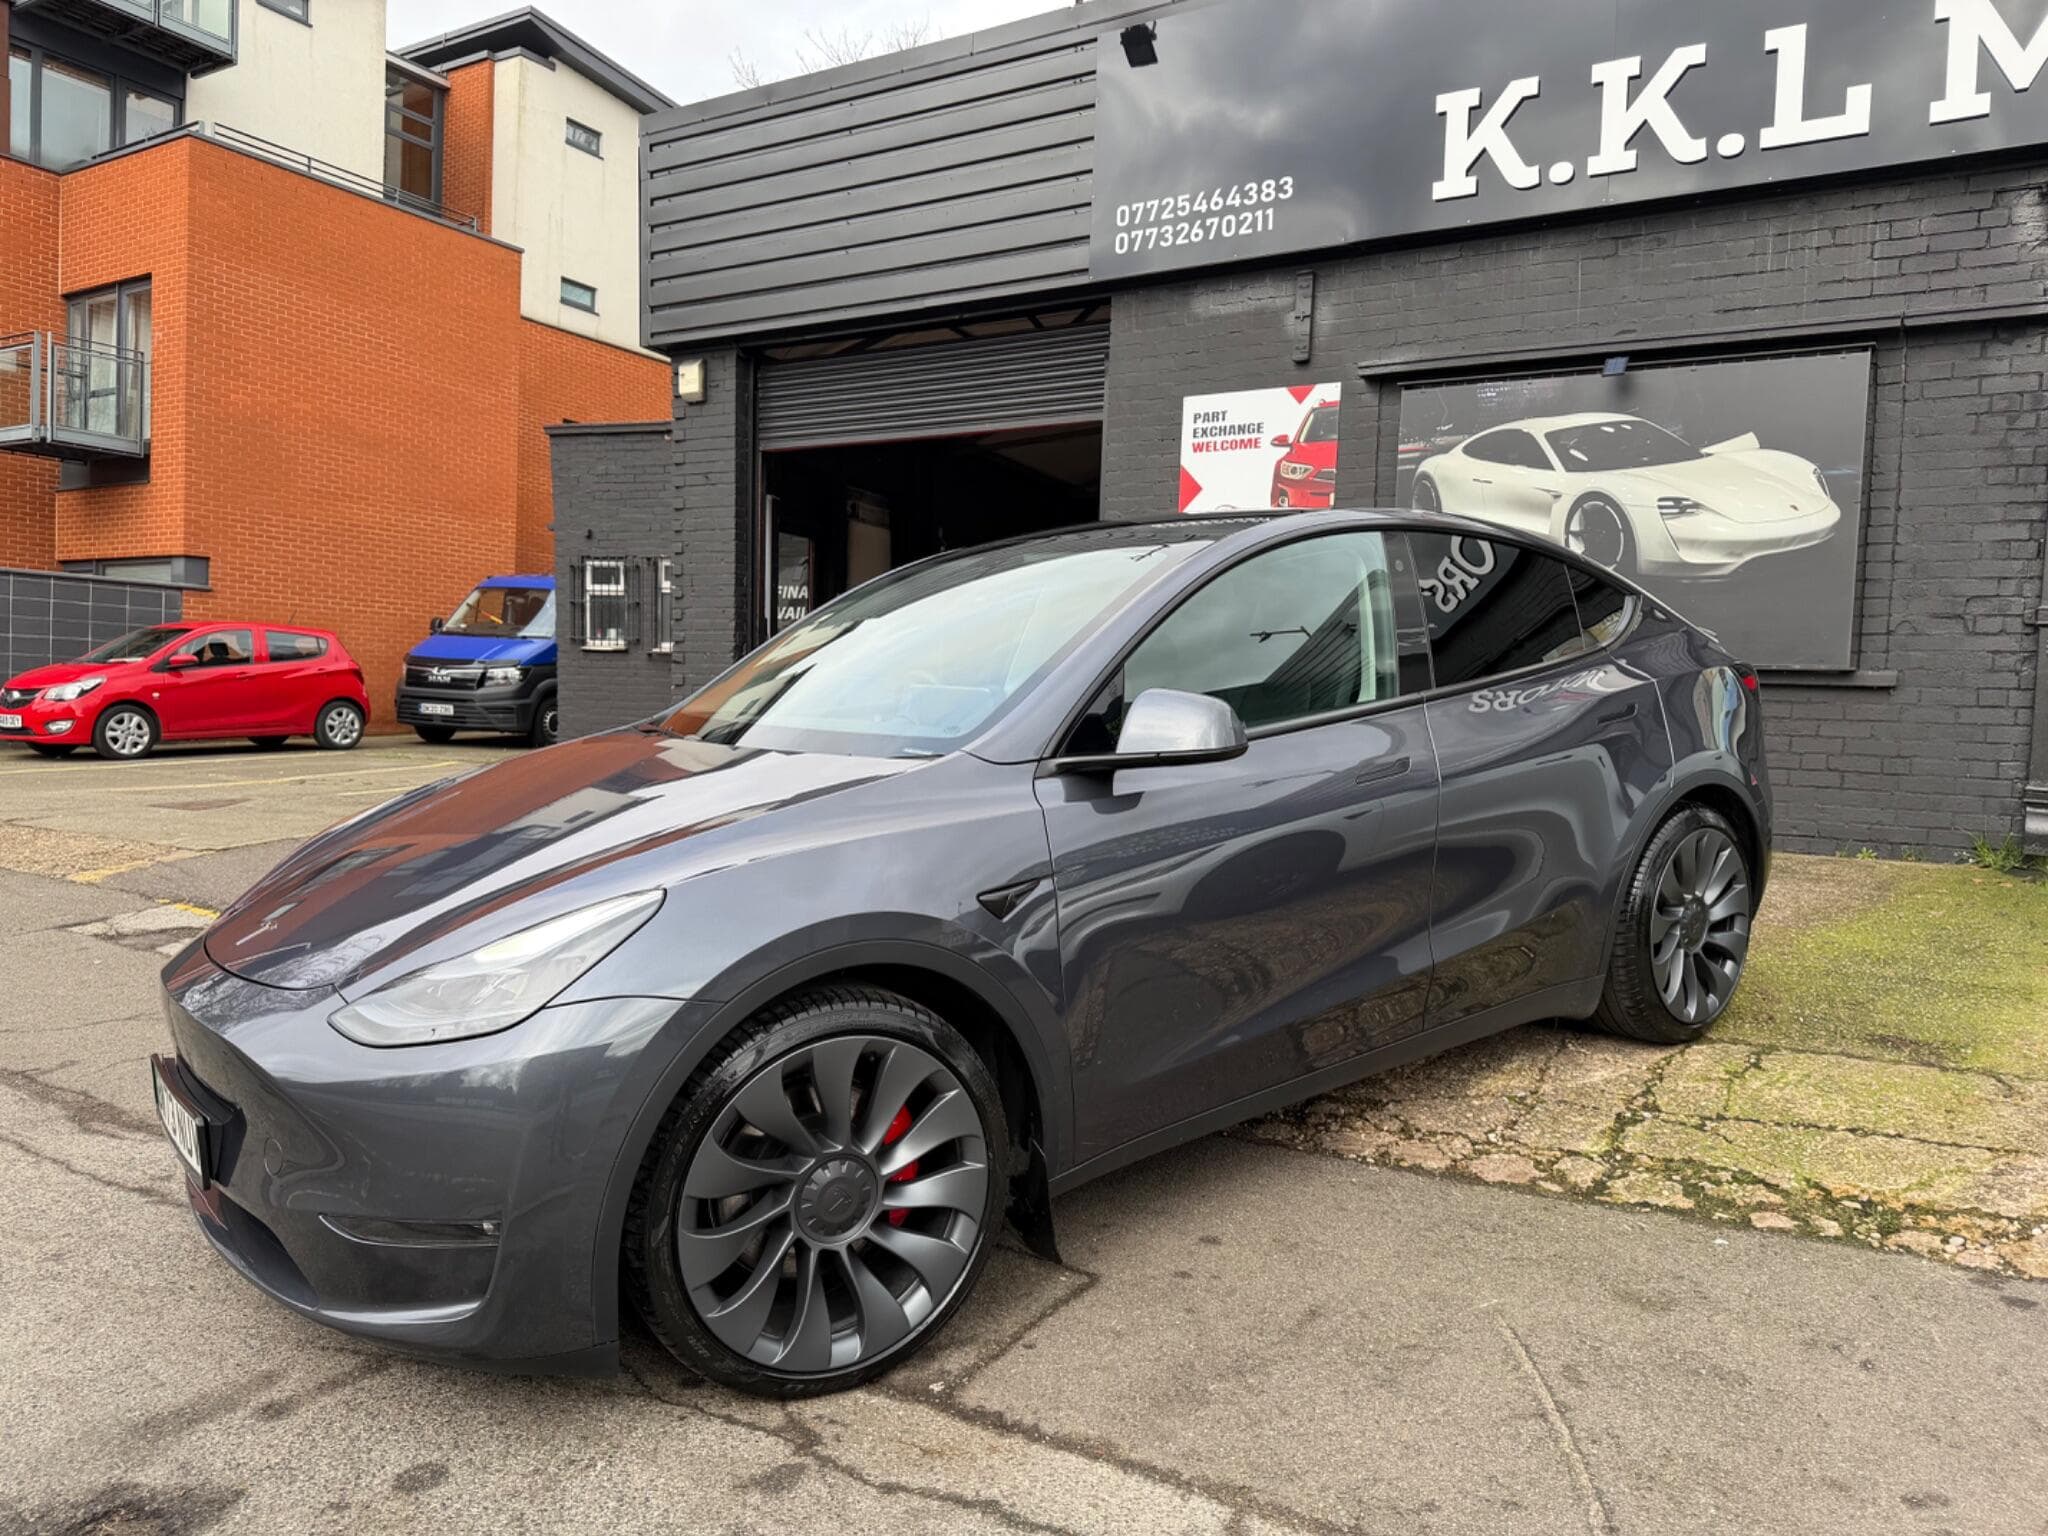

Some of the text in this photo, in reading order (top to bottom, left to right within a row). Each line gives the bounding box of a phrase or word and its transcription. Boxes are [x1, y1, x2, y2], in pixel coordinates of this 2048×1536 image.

[1432, 22, 1873, 200] K.K.L
[1115, 175, 1294, 227] 07725464383
[1114, 207, 1275, 255] 07732670211
[1192, 421, 1265, 439] EXCHANGE
[1193, 410, 1228, 424] PART
[1191, 437, 1262, 453] WELCOME
